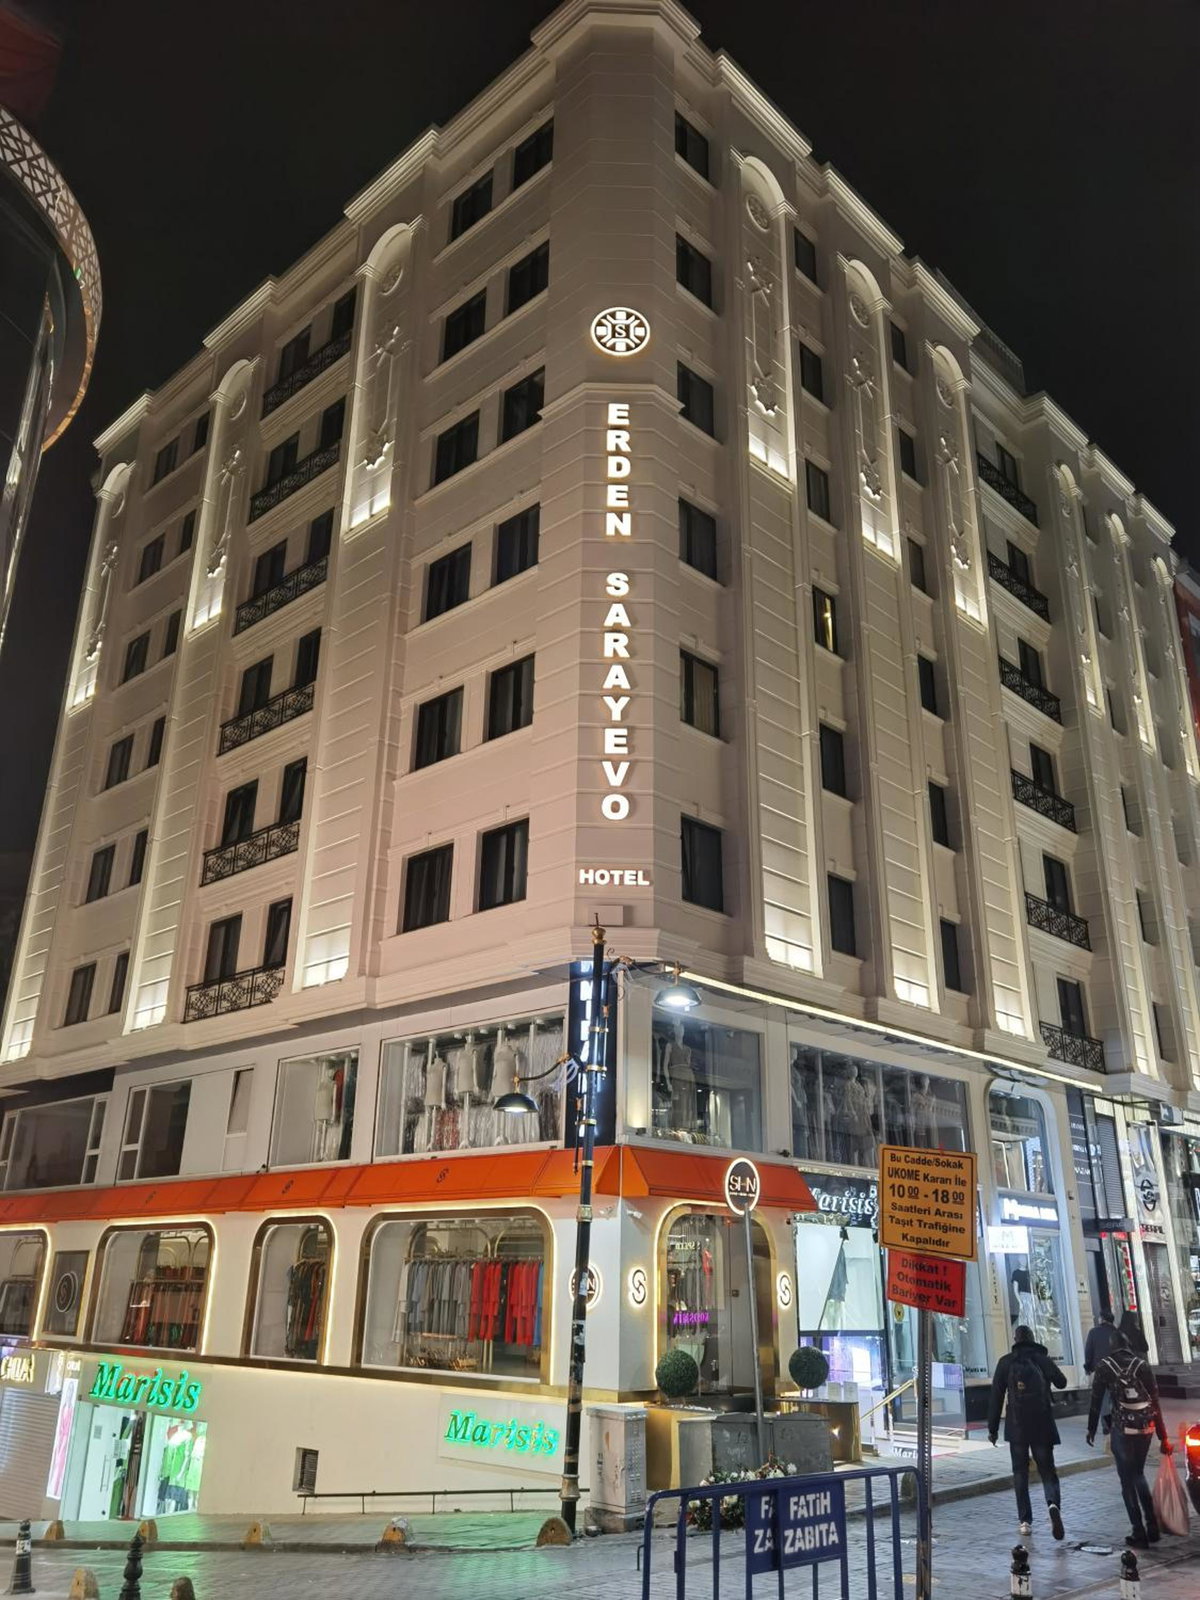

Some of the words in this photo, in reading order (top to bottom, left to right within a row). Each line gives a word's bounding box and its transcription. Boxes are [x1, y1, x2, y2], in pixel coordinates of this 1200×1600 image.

[605, 403, 632, 536] ERDEN
[601, 572, 631, 820] SARAYEVO
[579, 868, 650, 886] HOTEL
[890, 1153, 902, 1163] Bu
[904, 1155, 964, 1170] Cadde/Sokak
[887, 1166, 920, 1181] UKOME
[923, 1173, 952, 1185] Kararı
[891, 1202, 931, 1216] Saatleri
[934, 1208, 963, 1220] Arası
[888, 1215, 913, 1228] Taşıt
[916, 1219, 966, 1234] Trafiğine
[902, 1232, 951, 1248] Kapalıdır
[901, 1258, 939, 1275] Dikkat
[896, 1271, 952, 1293] Otomatik
[892, 1283, 930, 1305] Bariyer
[935, 1294, 957, 1308] Var
[89, 1362, 201, 1413] Marisis
[444, 1409, 559, 1456] Marisis
[893, 1446, 918, 1459] Mari
[784, 1521, 839, 1554] ZABITA
